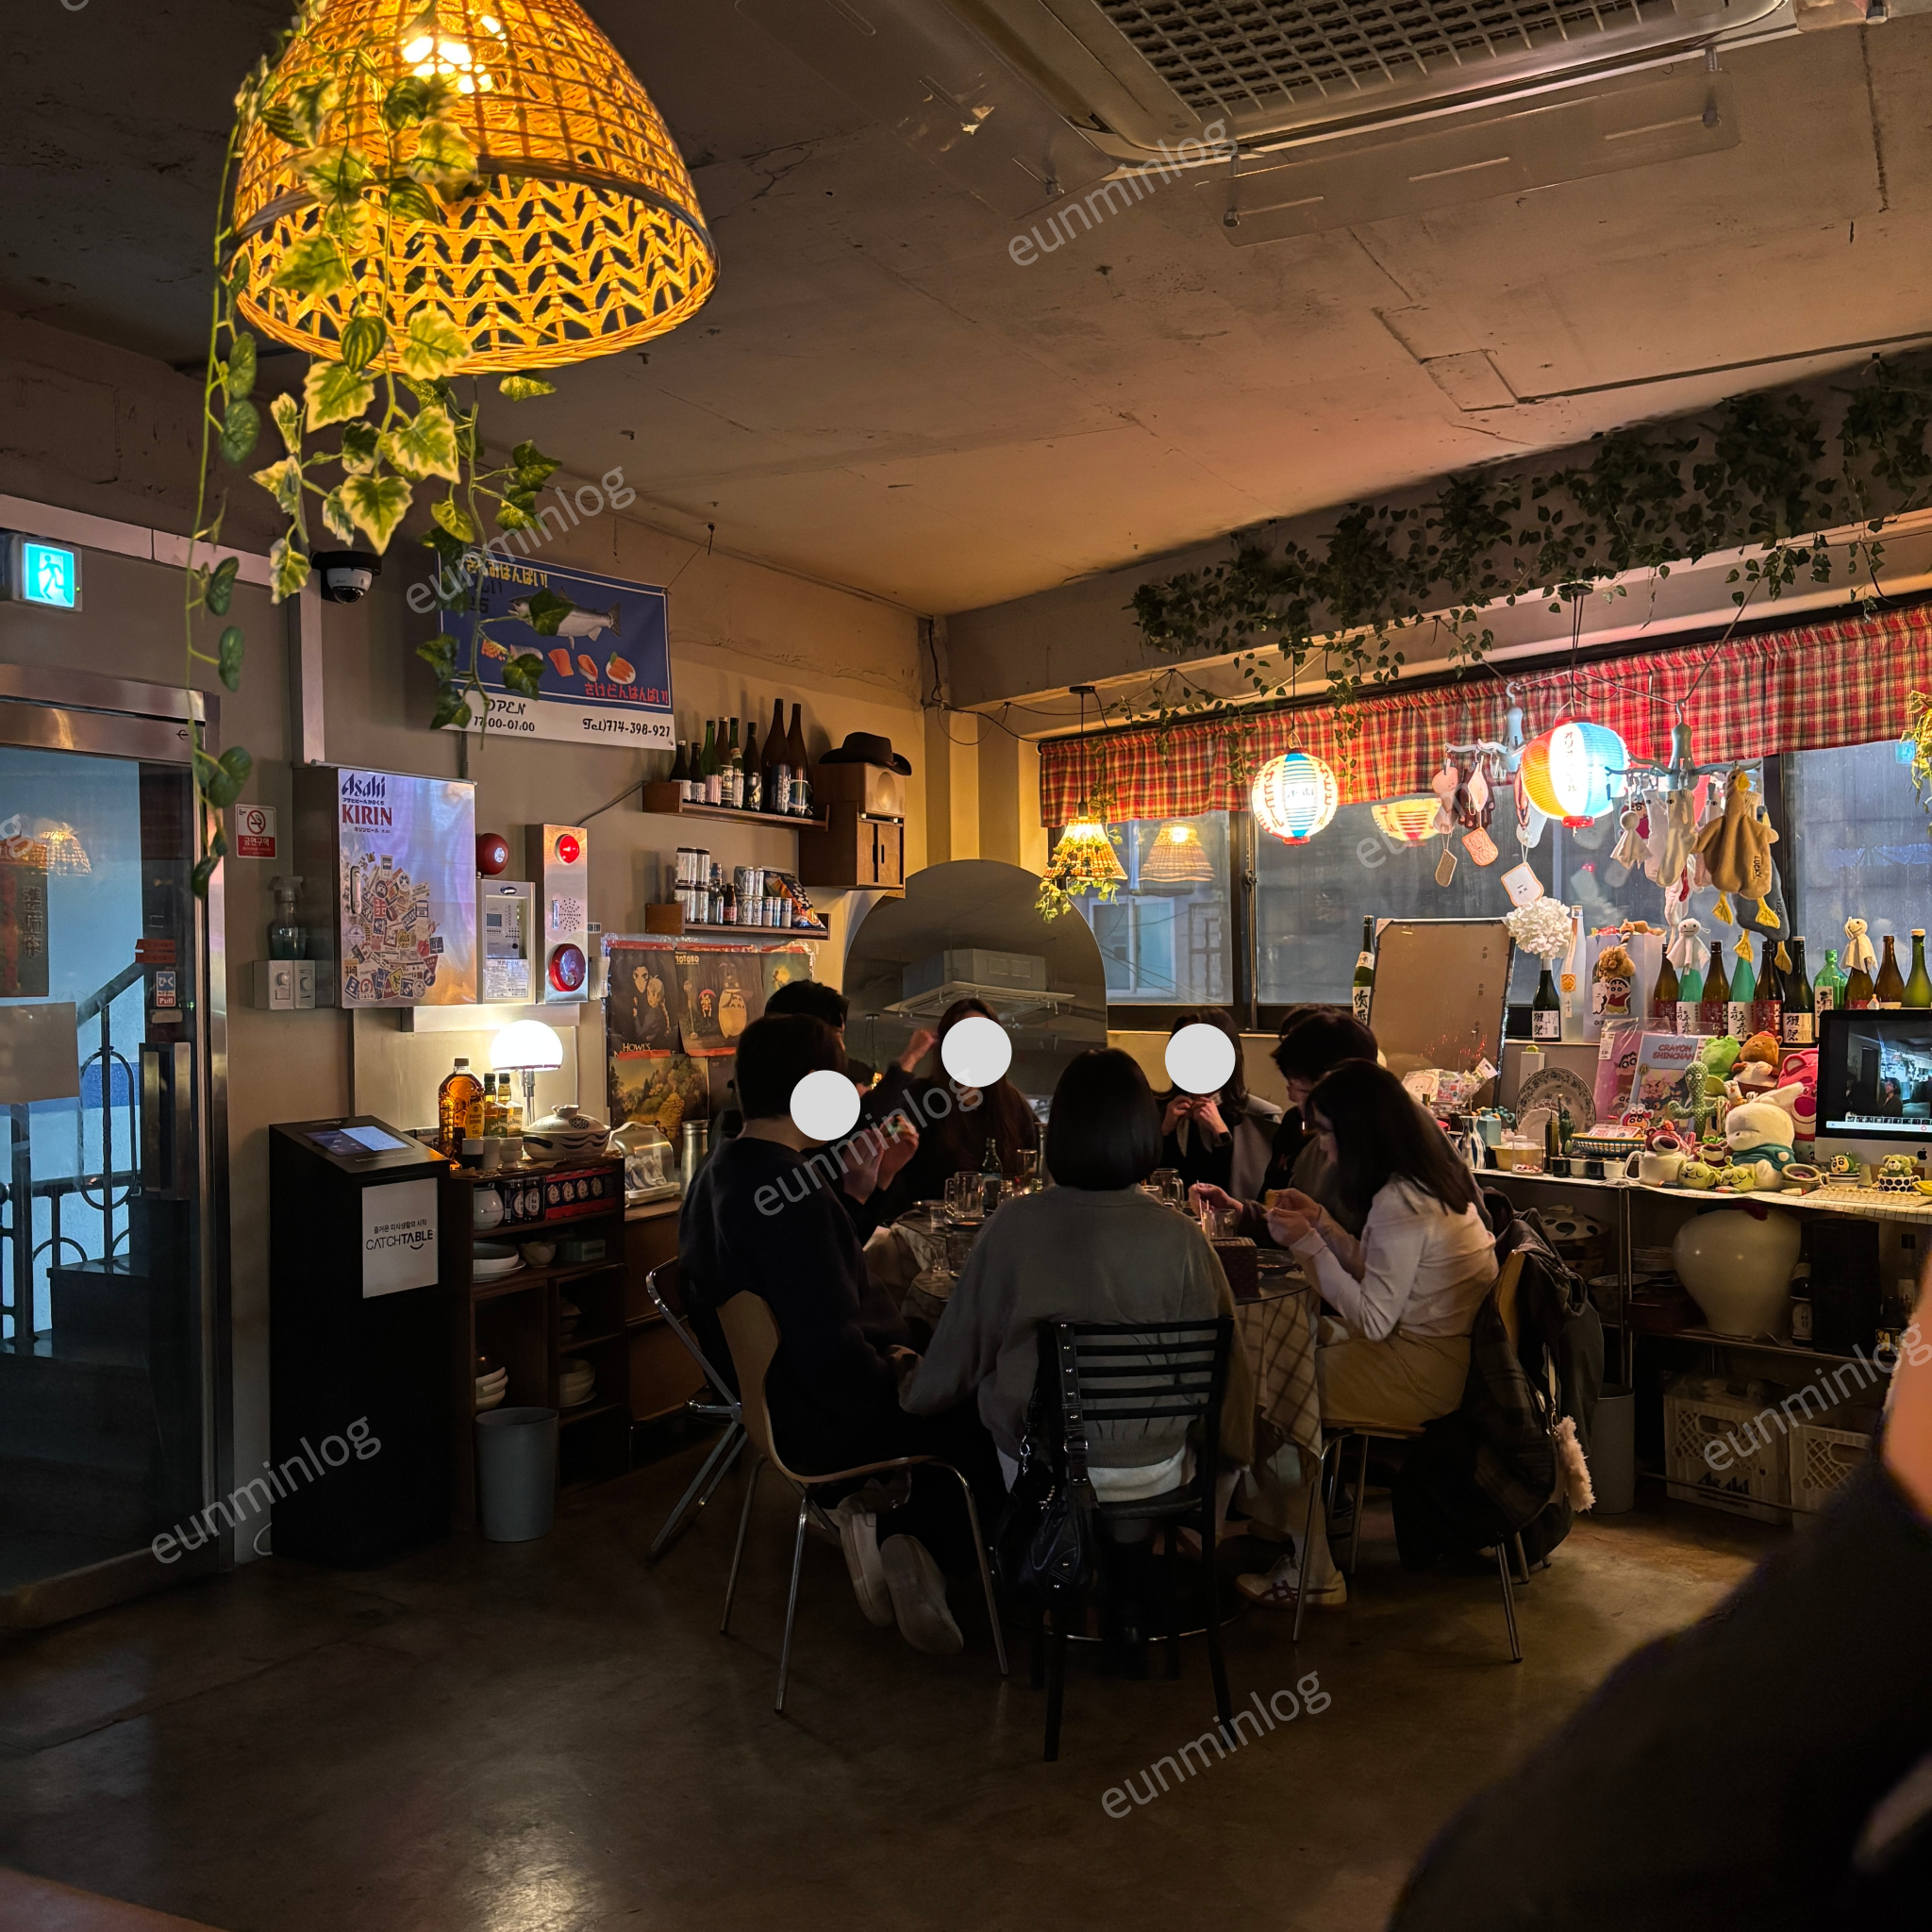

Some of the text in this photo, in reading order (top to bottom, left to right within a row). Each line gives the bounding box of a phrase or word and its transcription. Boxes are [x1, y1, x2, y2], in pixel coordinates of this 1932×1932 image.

[474, 716, 535, 732] 1700-01:00
[341, 773, 386, 798] Asahi
[341, 804, 392, 826] KIRIN
[244, 837, 270, 847] 금연구역
[158, 975, 175, 988] ひく
[623, 1042, 651, 1053] HOWL'S
[1658, 1044, 1693, 1053] CRAYON
[1653, 1051, 1694, 1060] SHINCHAN
[366, 1229, 434, 1251] CATCHTABLE
